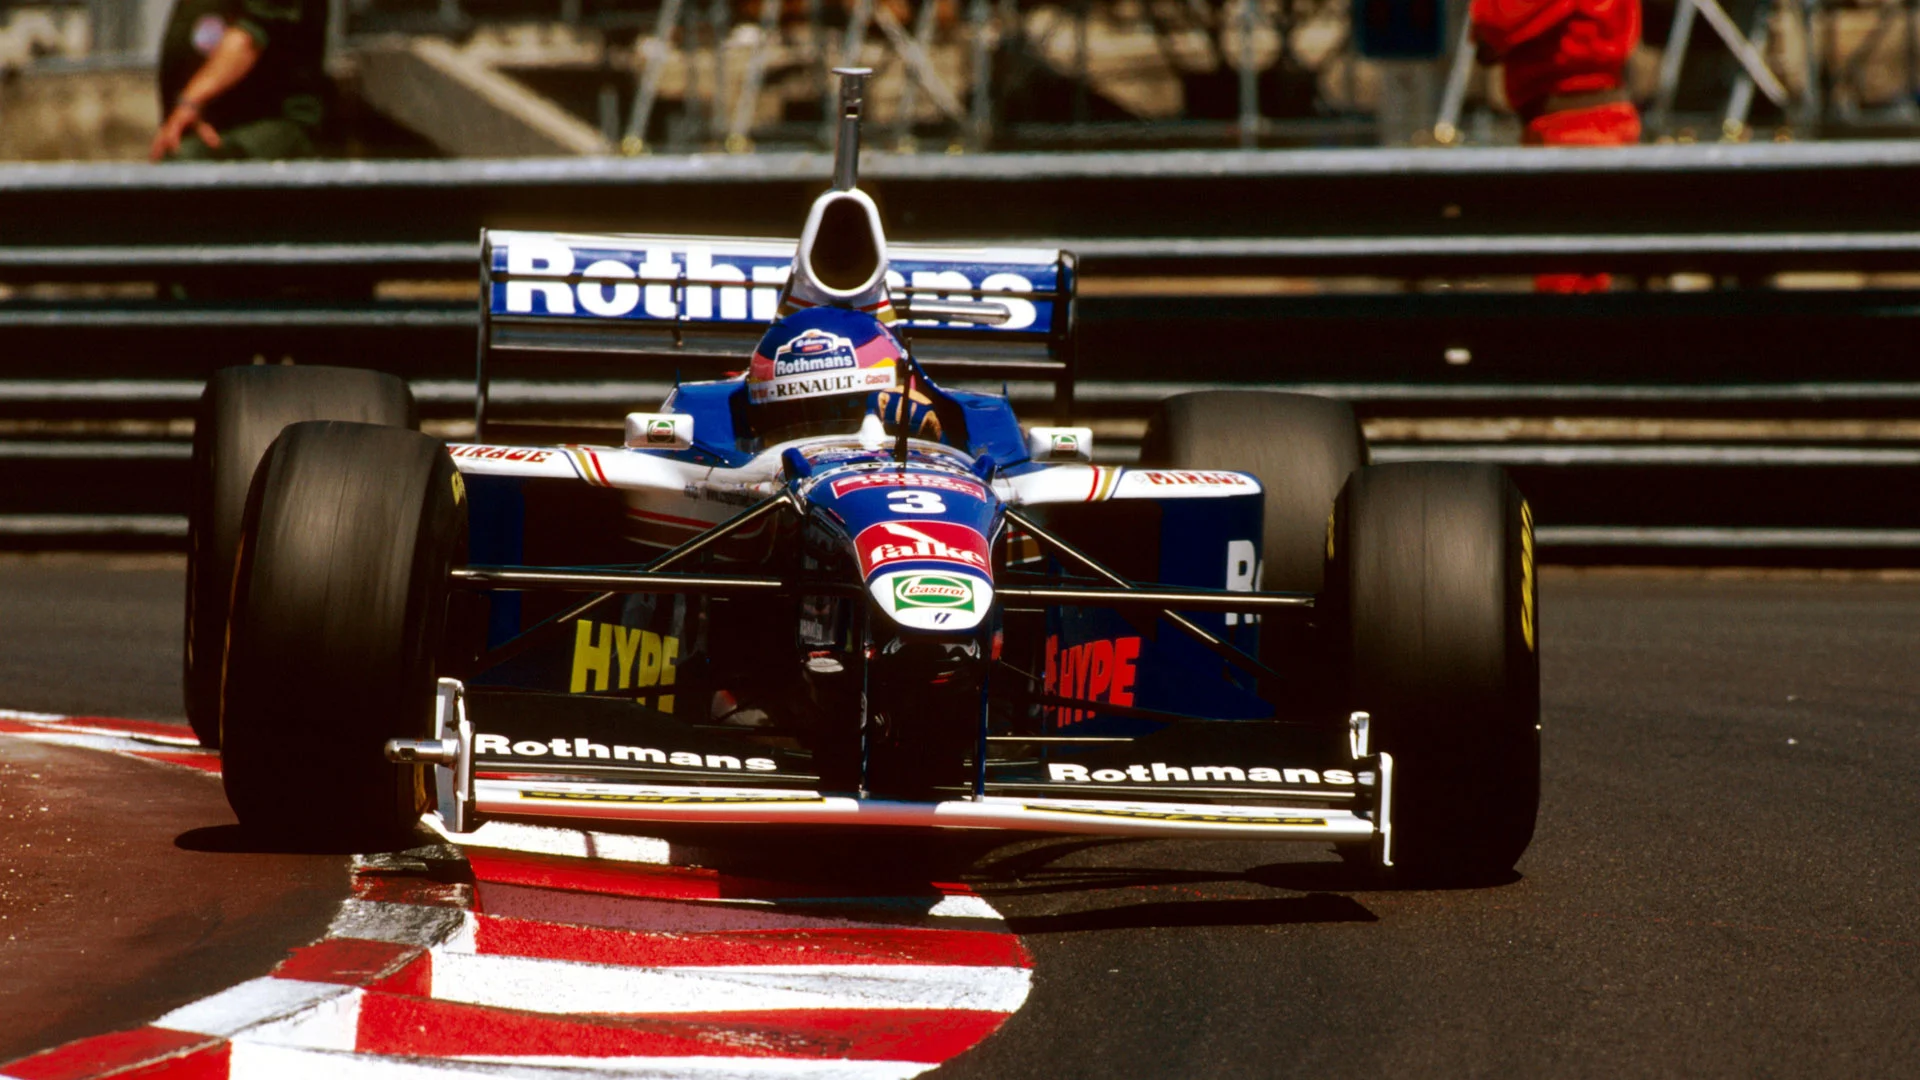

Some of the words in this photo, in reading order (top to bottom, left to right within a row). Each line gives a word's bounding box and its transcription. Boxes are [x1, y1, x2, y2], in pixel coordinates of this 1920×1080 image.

[776, 355, 853, 375] Rothmans
[776, 375, 854, 397] RENAULT
[1145, 471, 1247, 485] MIRAGE
[886, 490, 946, 514] 3
[870, 540, 986, 567] falke
[909, 585, 966, 597] Castrol
[570, 619, 679, 713] HYPE
[475, 733, 777, 770] Rothmans
[1048, 763, 1355, 784] Rothmans
